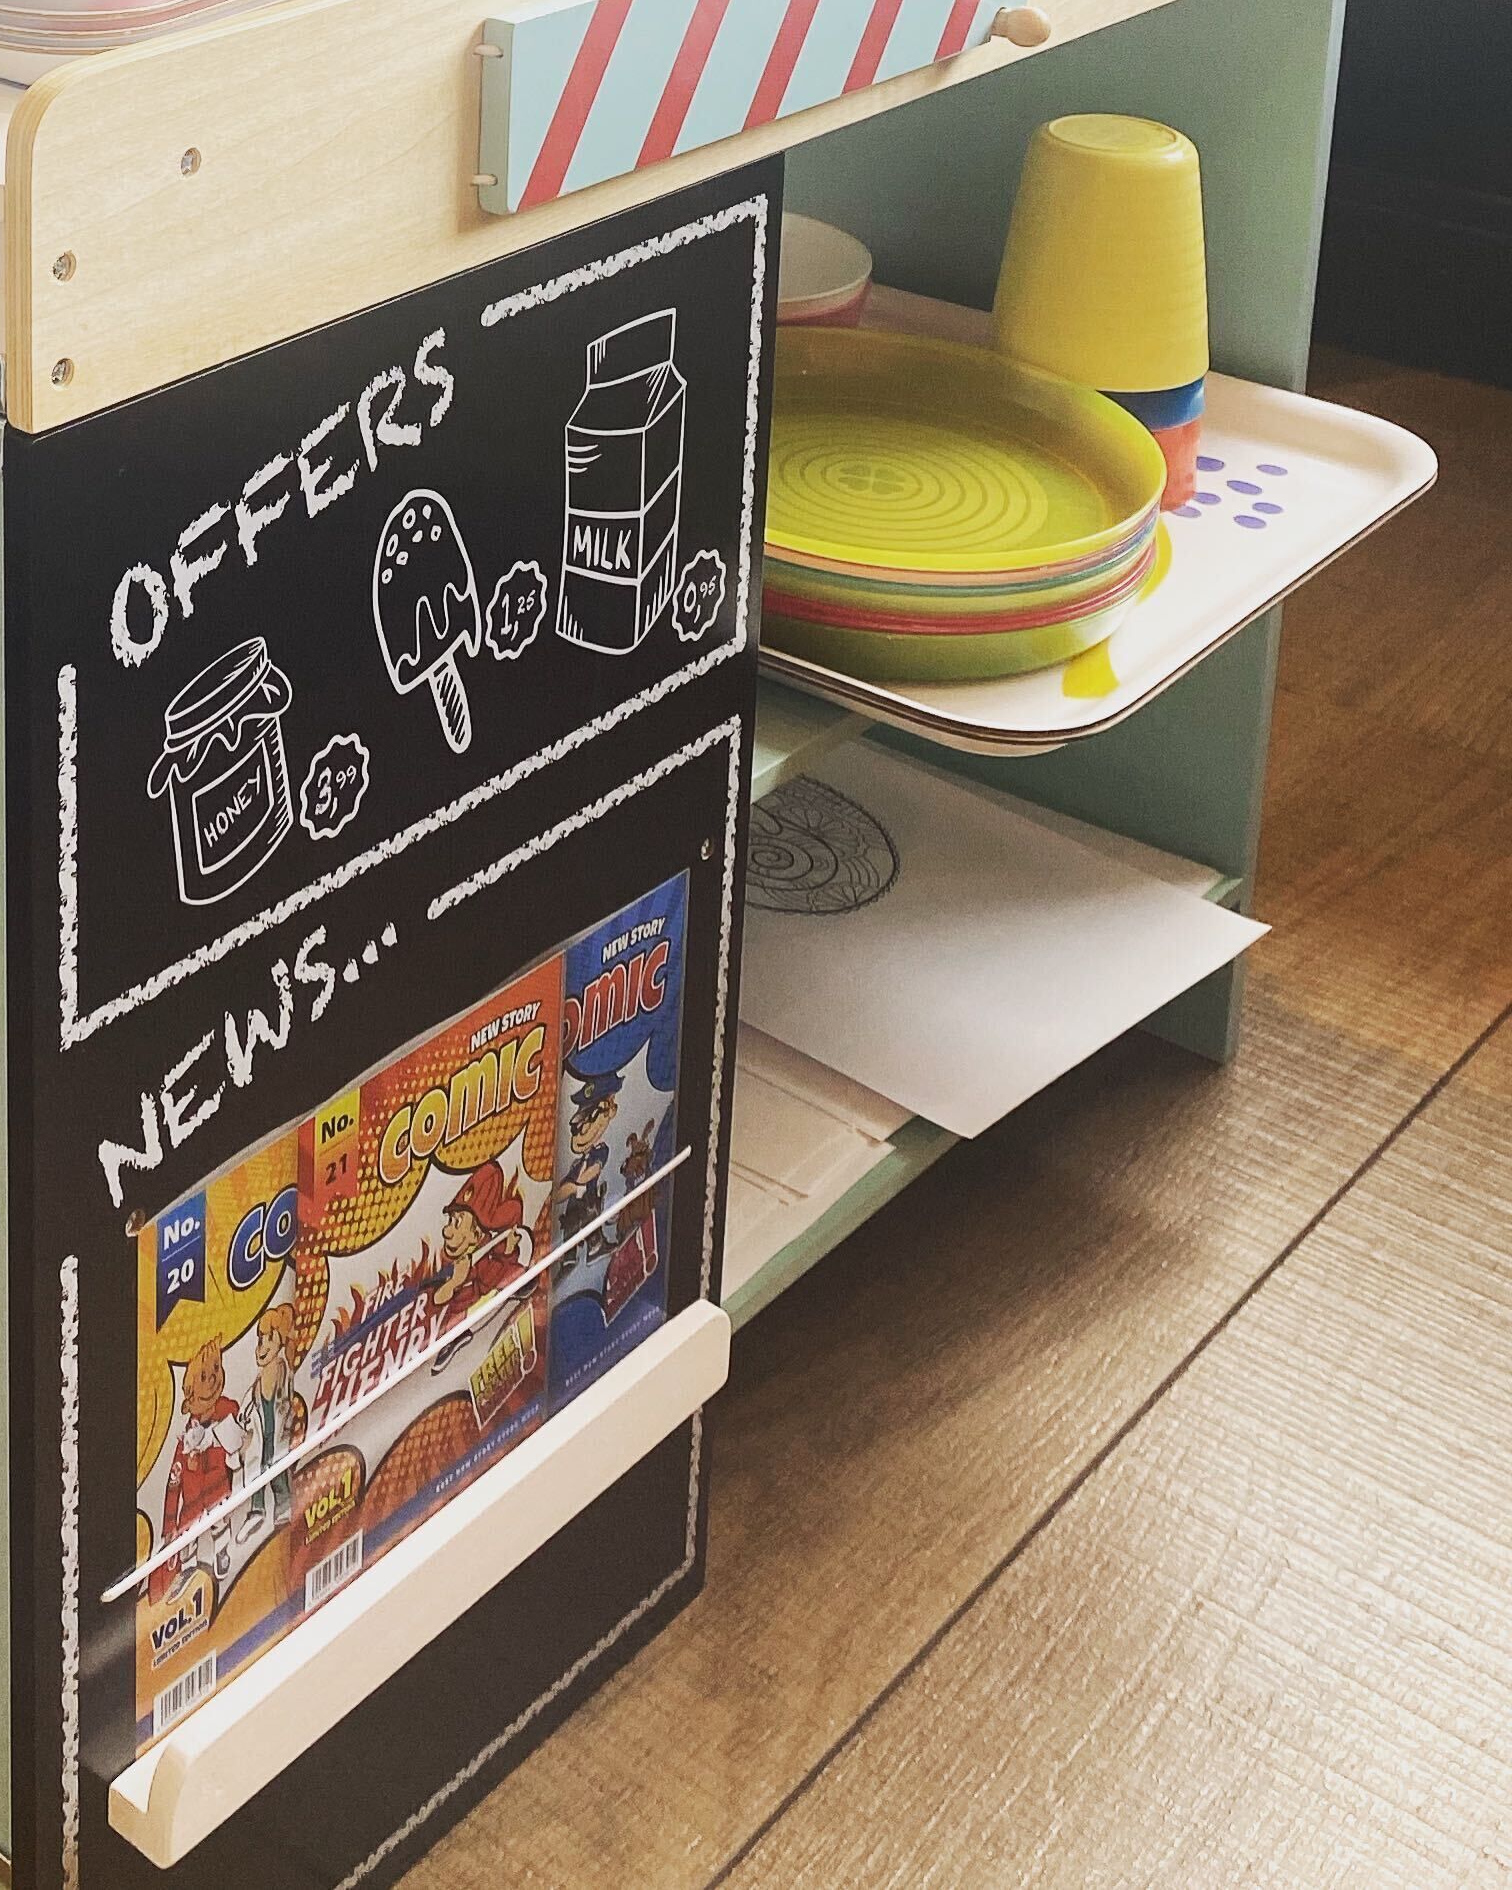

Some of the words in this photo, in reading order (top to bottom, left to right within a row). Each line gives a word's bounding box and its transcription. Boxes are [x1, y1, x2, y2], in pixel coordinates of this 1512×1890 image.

[110, 327, 455, 668] OFFERS
[573, 526, 633, 572] MILK
[203, 766, 263, 848] HONEY
[602, 933, 629, 963] NEW
[629, 916, 666, 946] STORY
[470, 1025, 501, 1053] NEW
[501, 1001, 542, 1032] STORY
[321, 1112, 355, 1144] No.
[325, 1152, 348, 1186] 21
[162, 1216, 202, 1251] No.
[166, 1258, 195, 1295] 20
[360, 1276, 406, 1324] FIRE
[315, 1292, 428, 1400] FIGHTER
